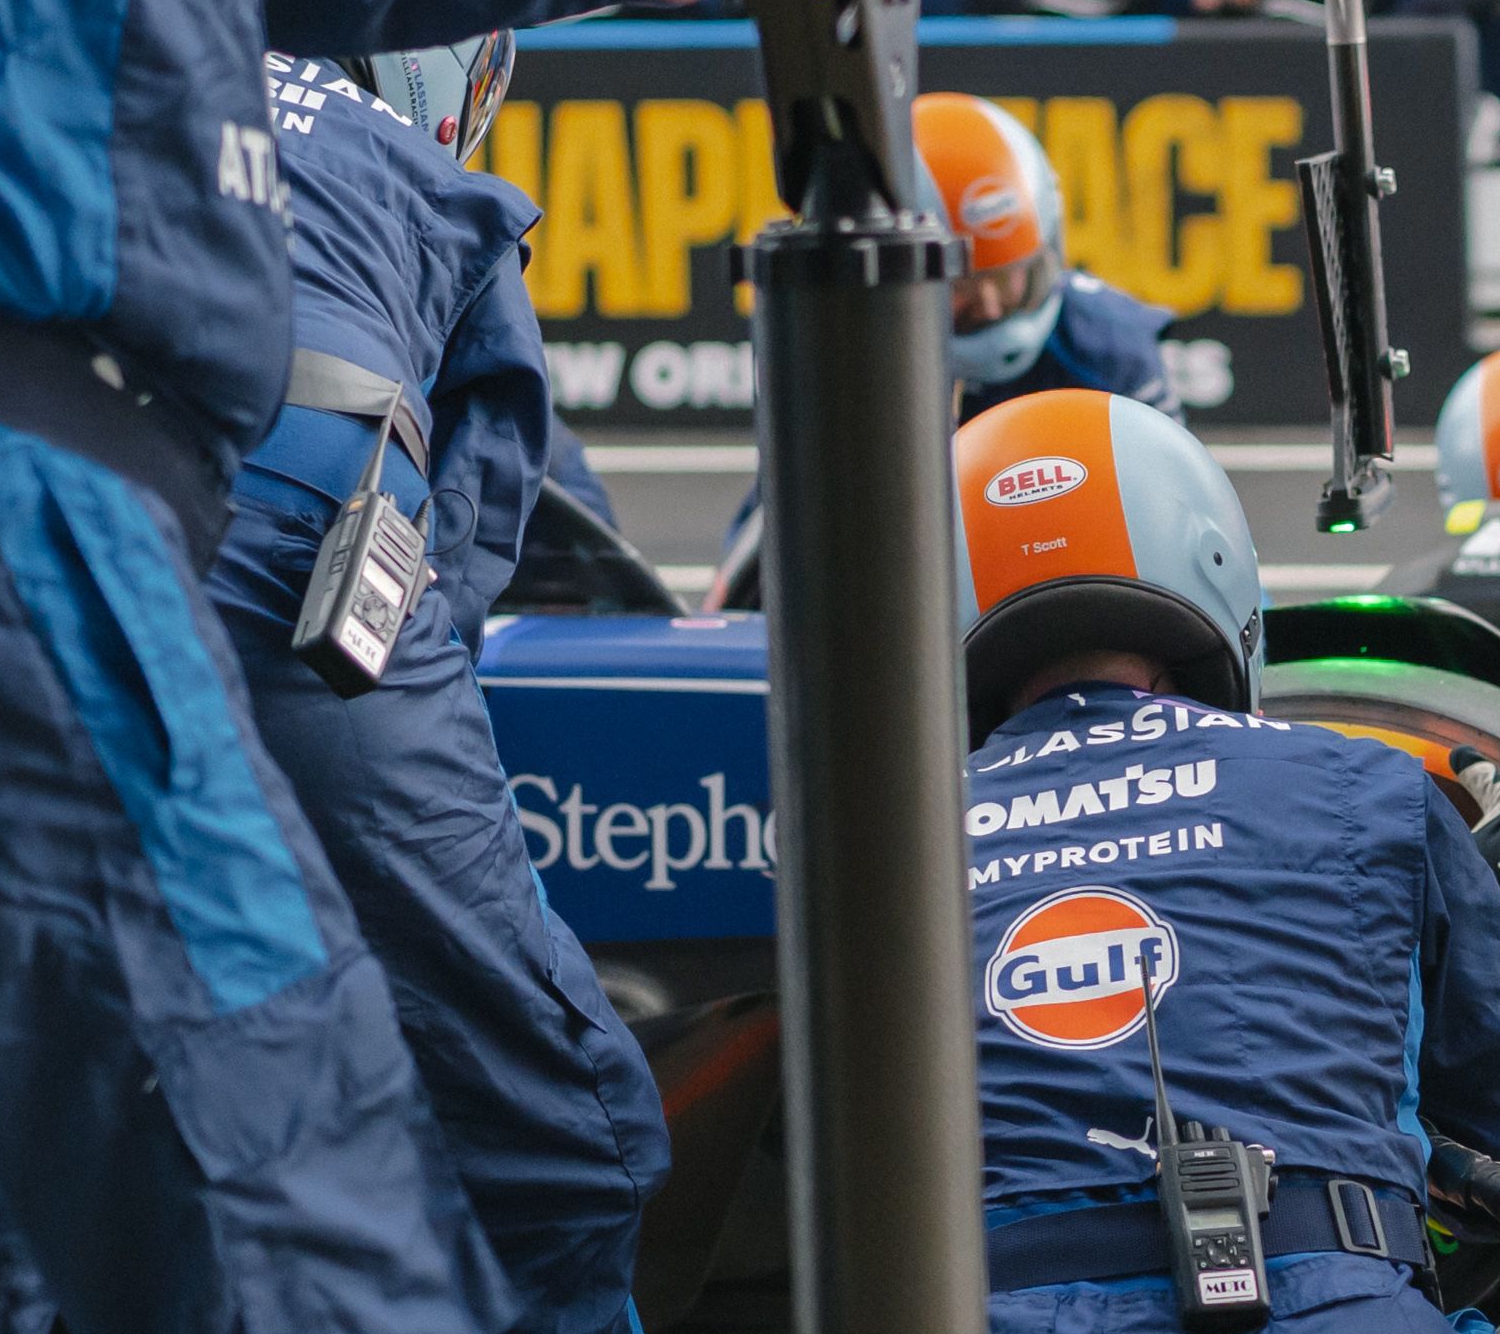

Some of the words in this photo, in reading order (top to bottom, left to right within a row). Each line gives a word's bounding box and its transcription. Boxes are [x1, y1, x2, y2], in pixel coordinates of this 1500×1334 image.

[1000, 95, 1304, 315] ACE
[997, 465, 1072, 497] BELL
[1008, 484, 1063, 500] HELMETS
[1020, 544, 1030, 556] T
[1032, 537, 1068, 553] Scott
[968, 823, 1224, 890] MYPROTEIN
[997, 937, 1163, 1000] Gulf
